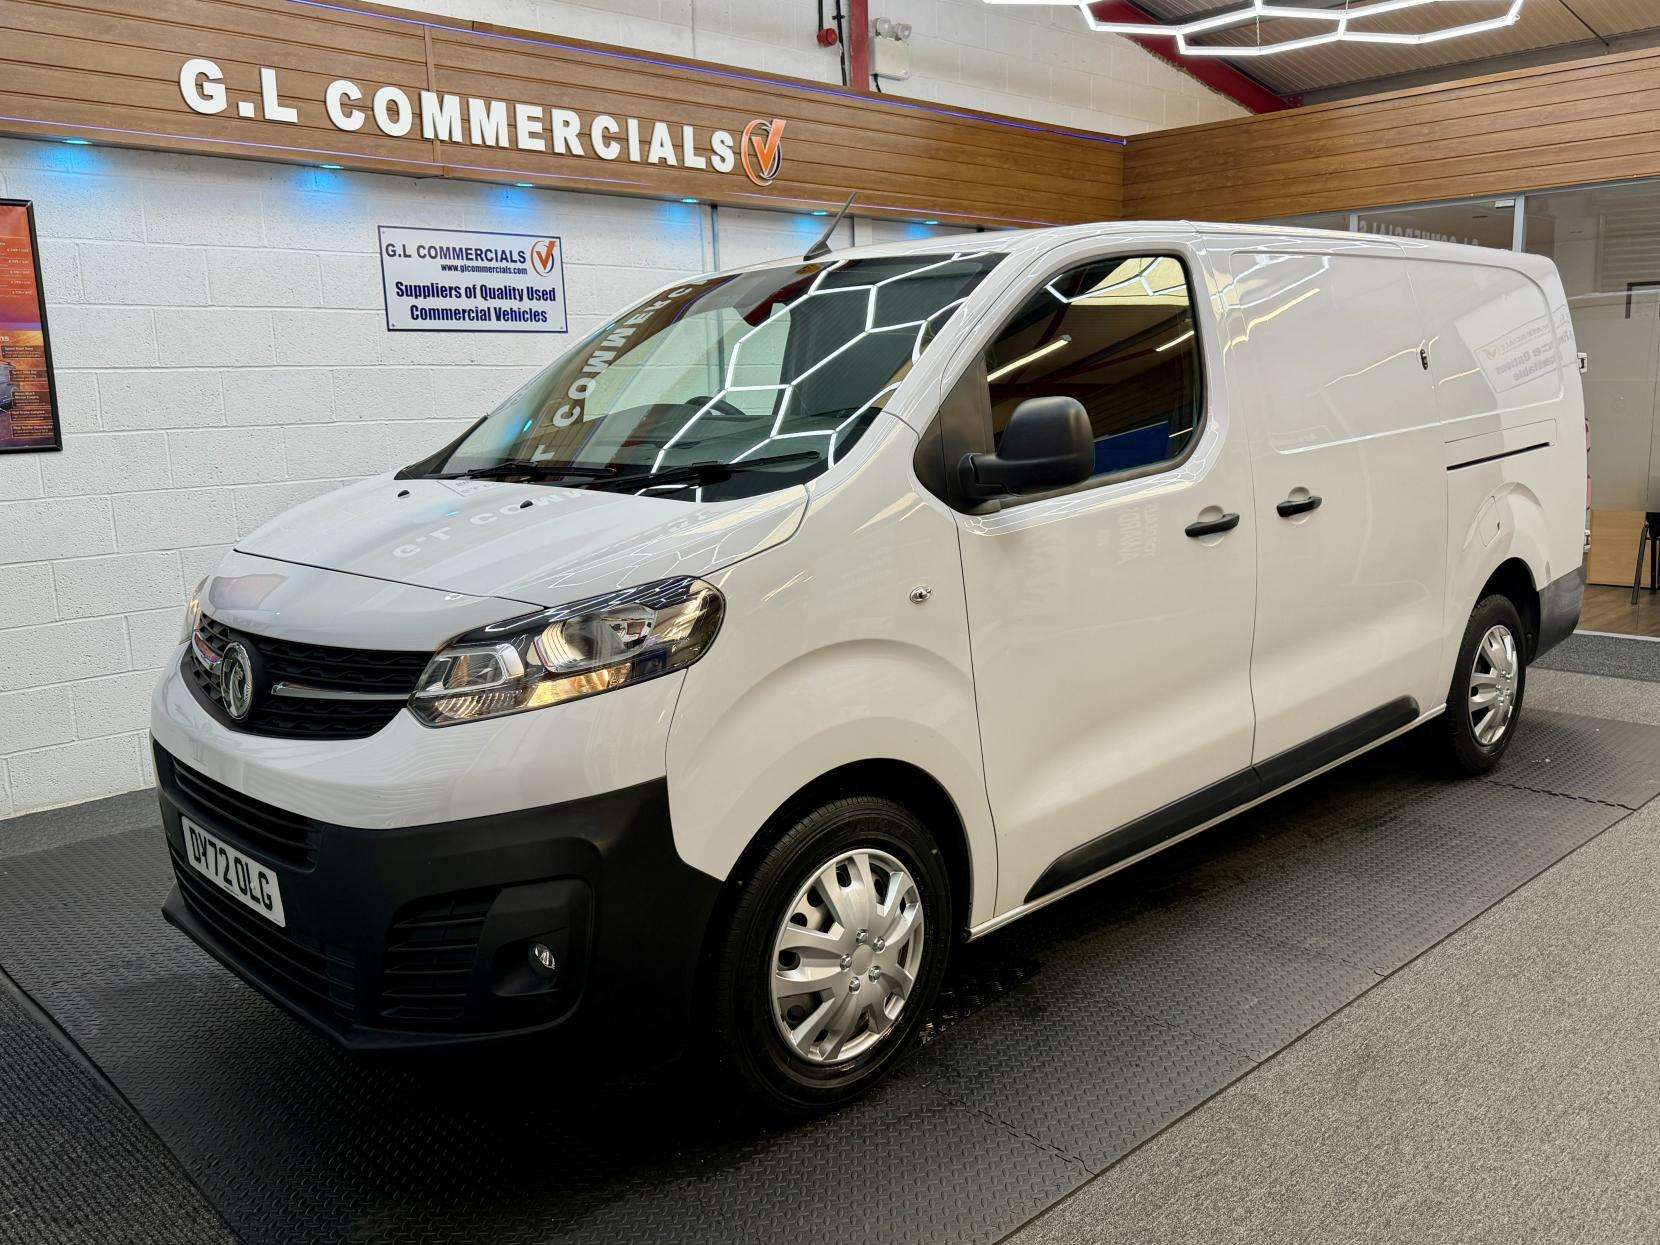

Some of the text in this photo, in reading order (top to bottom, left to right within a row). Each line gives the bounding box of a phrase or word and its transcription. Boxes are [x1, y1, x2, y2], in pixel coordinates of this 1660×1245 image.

[179, 58, 733, 173] G.L COMMERCIALS
[386, 244, 526, 263] G.L COMMERCIALS
[441, 264, 527, 274] www.glcommercials.com
[396, 281, 556, 302] Suppliers of Quality Used
[410, 305, 547, 322] Commercial Vehicles
[189, 826, 272, 911] DY72 OLG
